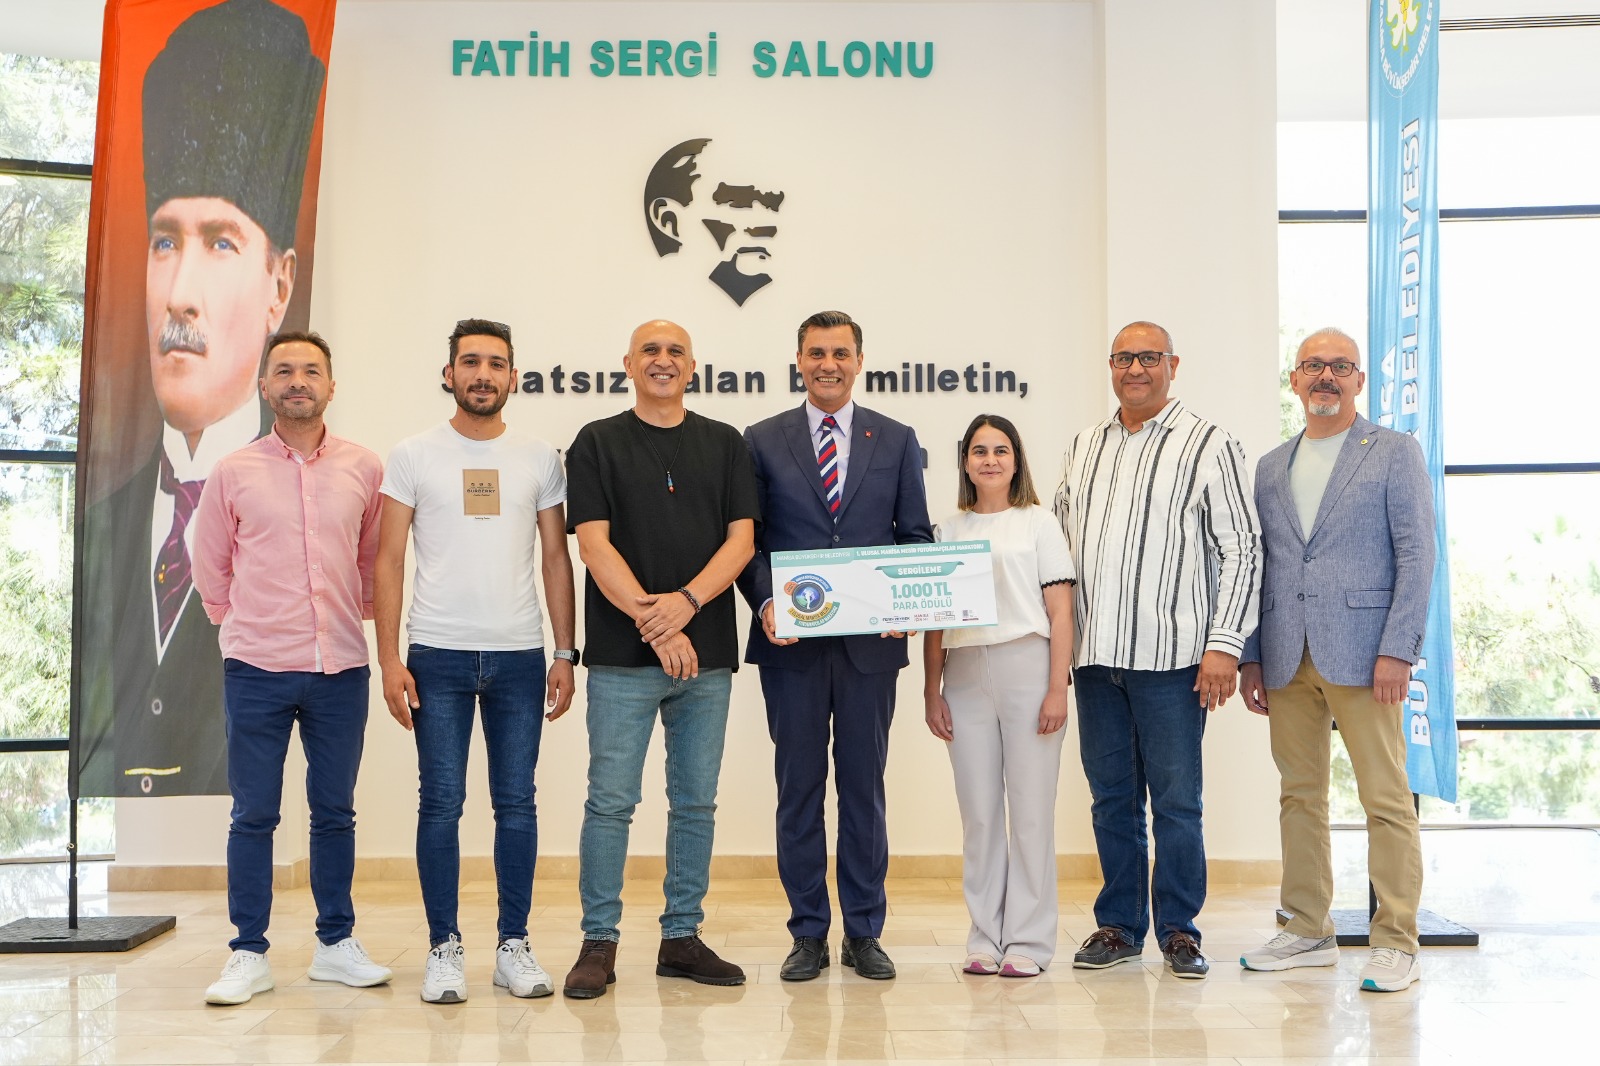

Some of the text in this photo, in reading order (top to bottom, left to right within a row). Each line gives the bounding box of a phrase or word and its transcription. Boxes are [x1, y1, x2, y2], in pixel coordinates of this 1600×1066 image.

[452, 31, 934, 77] FATİH SERGİ SALONU
[1400, 118, 1420, 415] BELEDİYESİ
[866, 362, 1028, 399] milletin,
[898, 565, 942, 575] SERGİLEME
[891, 581, 952, 599] 1.000 TL
[893, 597, 952, 610] PARA ÖDÜLÜ
